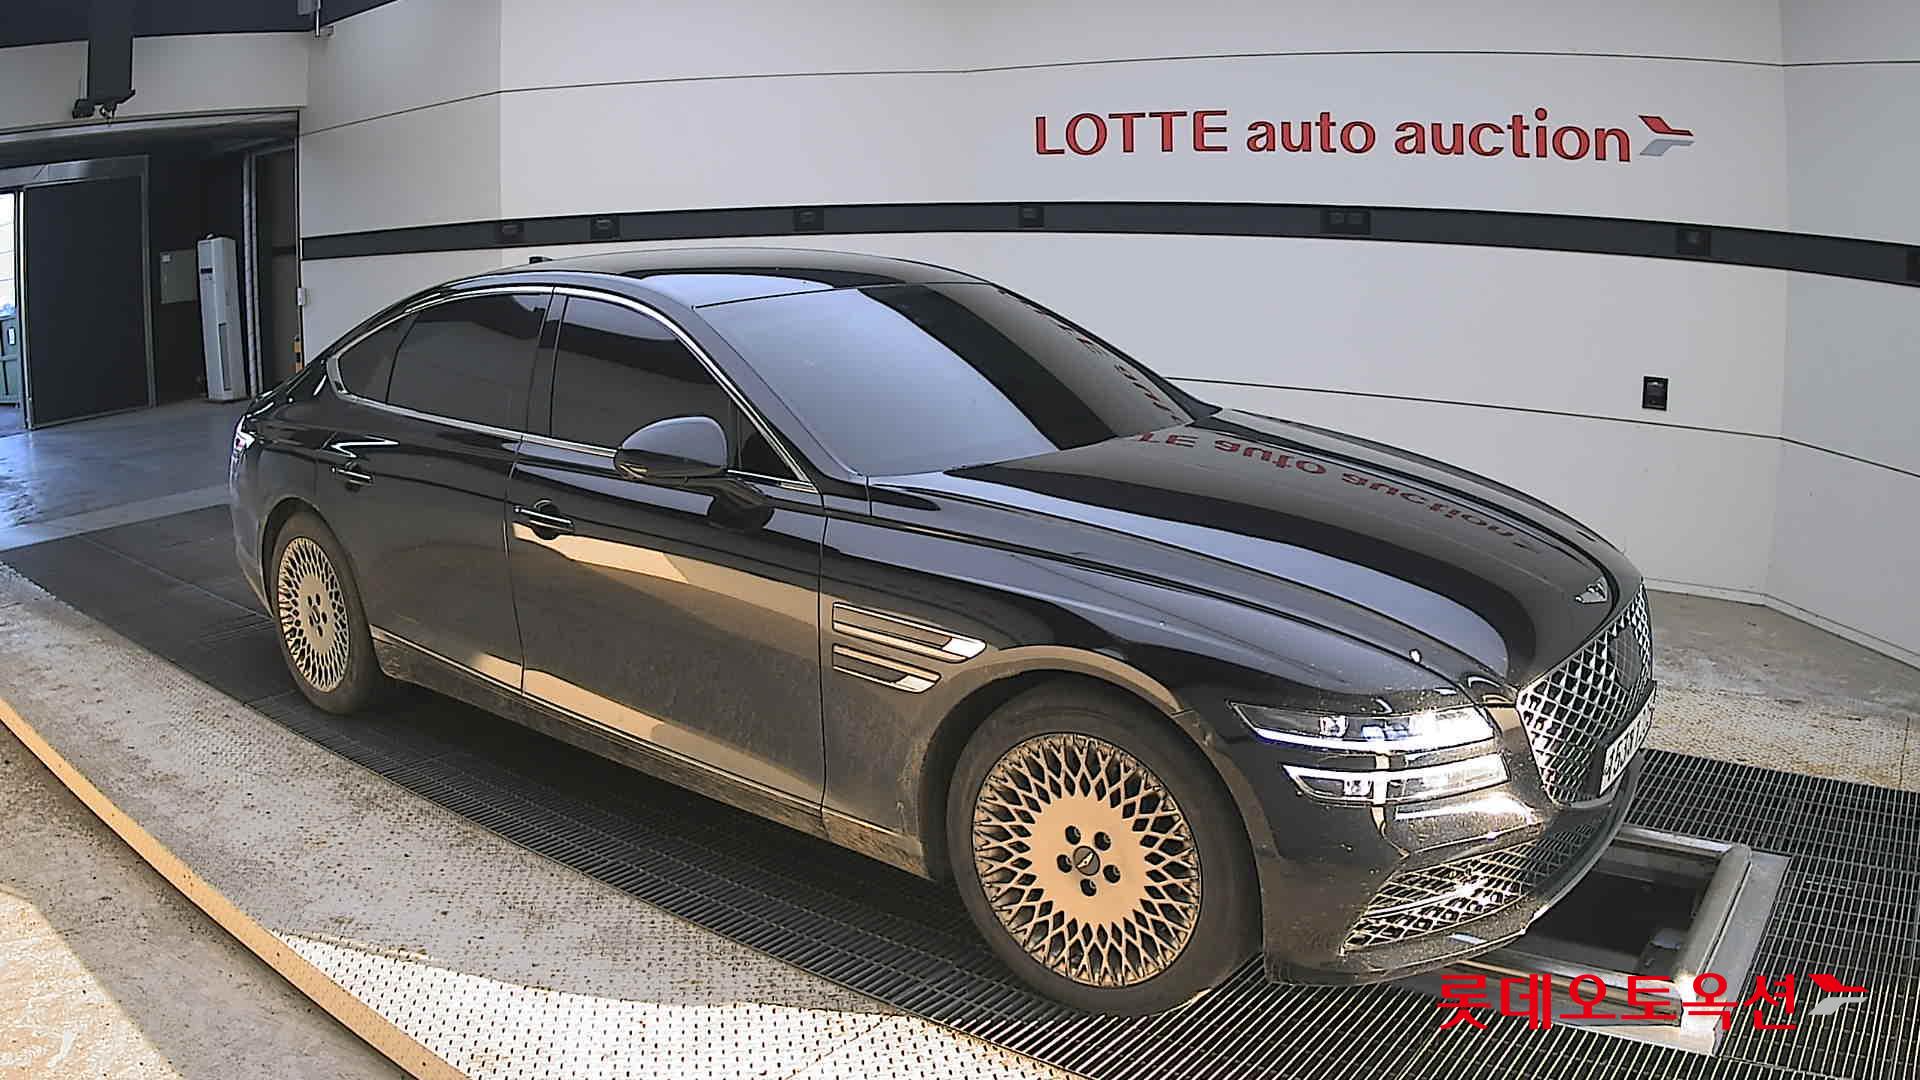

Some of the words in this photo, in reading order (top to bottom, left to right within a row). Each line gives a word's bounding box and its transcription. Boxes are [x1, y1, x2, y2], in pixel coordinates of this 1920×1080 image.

[1035, 110, 1228, 155] LOTTE
[1247, 112, 1376, 154] auto
[1394, 107, 1631, 162] auction
